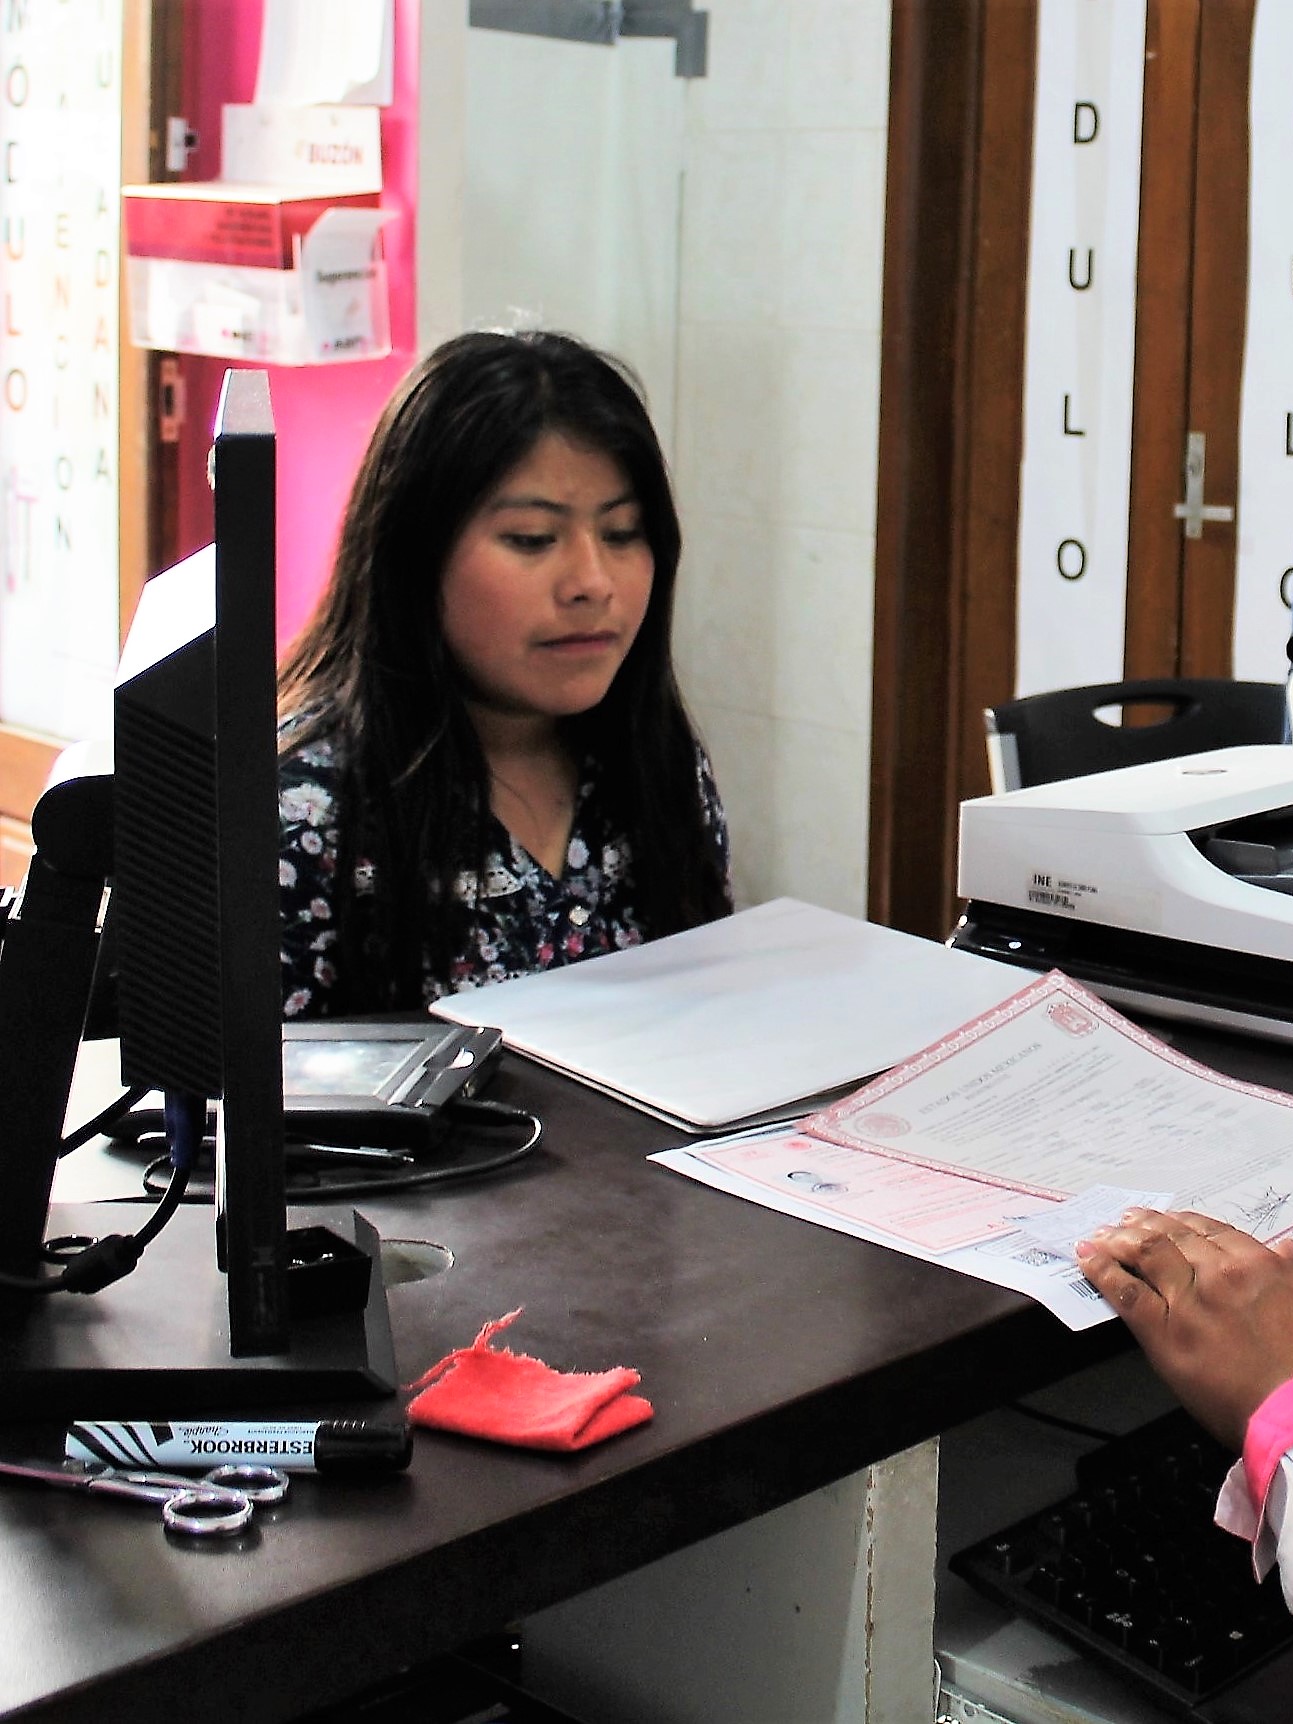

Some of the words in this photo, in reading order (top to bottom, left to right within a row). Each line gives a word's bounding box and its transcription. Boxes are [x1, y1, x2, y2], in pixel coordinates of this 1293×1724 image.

[1057, 102, 1100, 581] DULO
[1034, 873, 1051, 887] INE
[191, 1439, 313, 1455] ESTERBROOK
